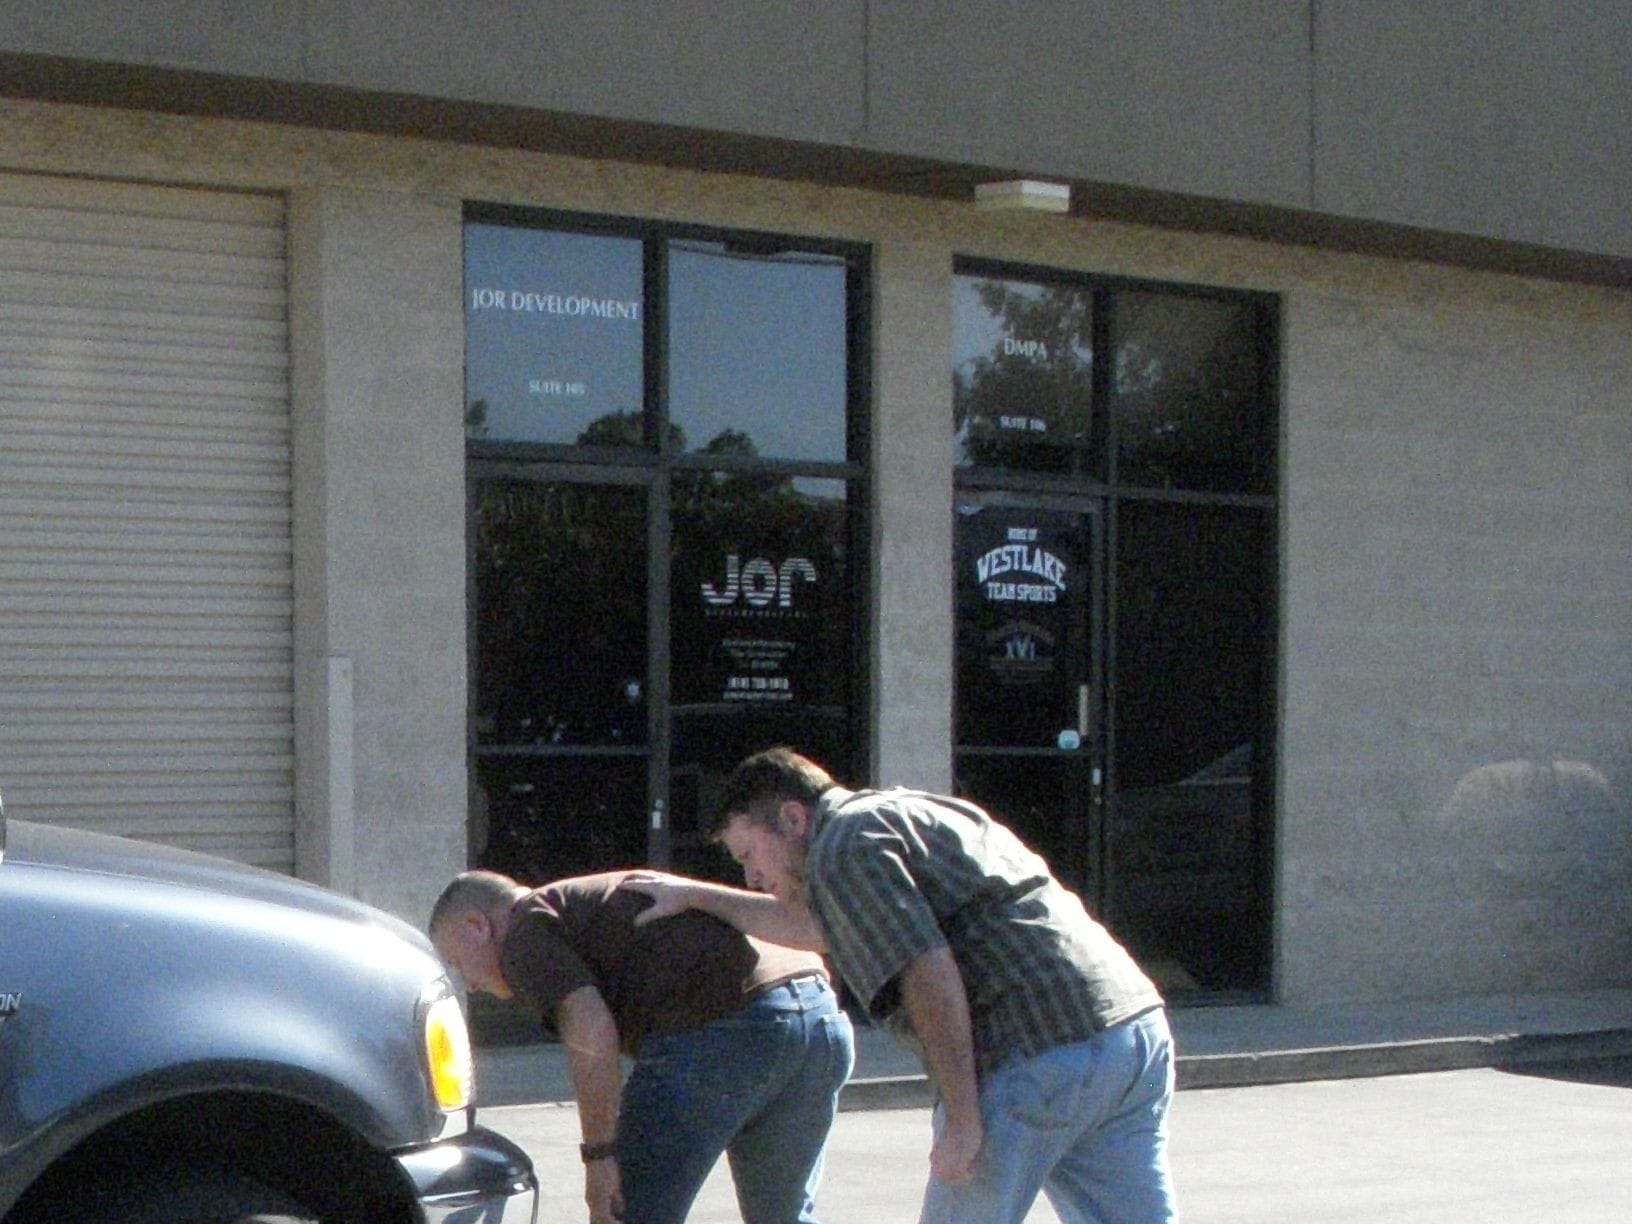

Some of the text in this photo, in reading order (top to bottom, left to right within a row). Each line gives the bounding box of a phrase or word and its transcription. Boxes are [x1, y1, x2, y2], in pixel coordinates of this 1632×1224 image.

[472, 287, 639, 320] JOR DEVELOPMENT
[1004, 337, 1047, 361] DMPA
[976, 544, 1066, 591] WESTLAKE
[988, 582, 1057, 602] TEAM SPORTS
